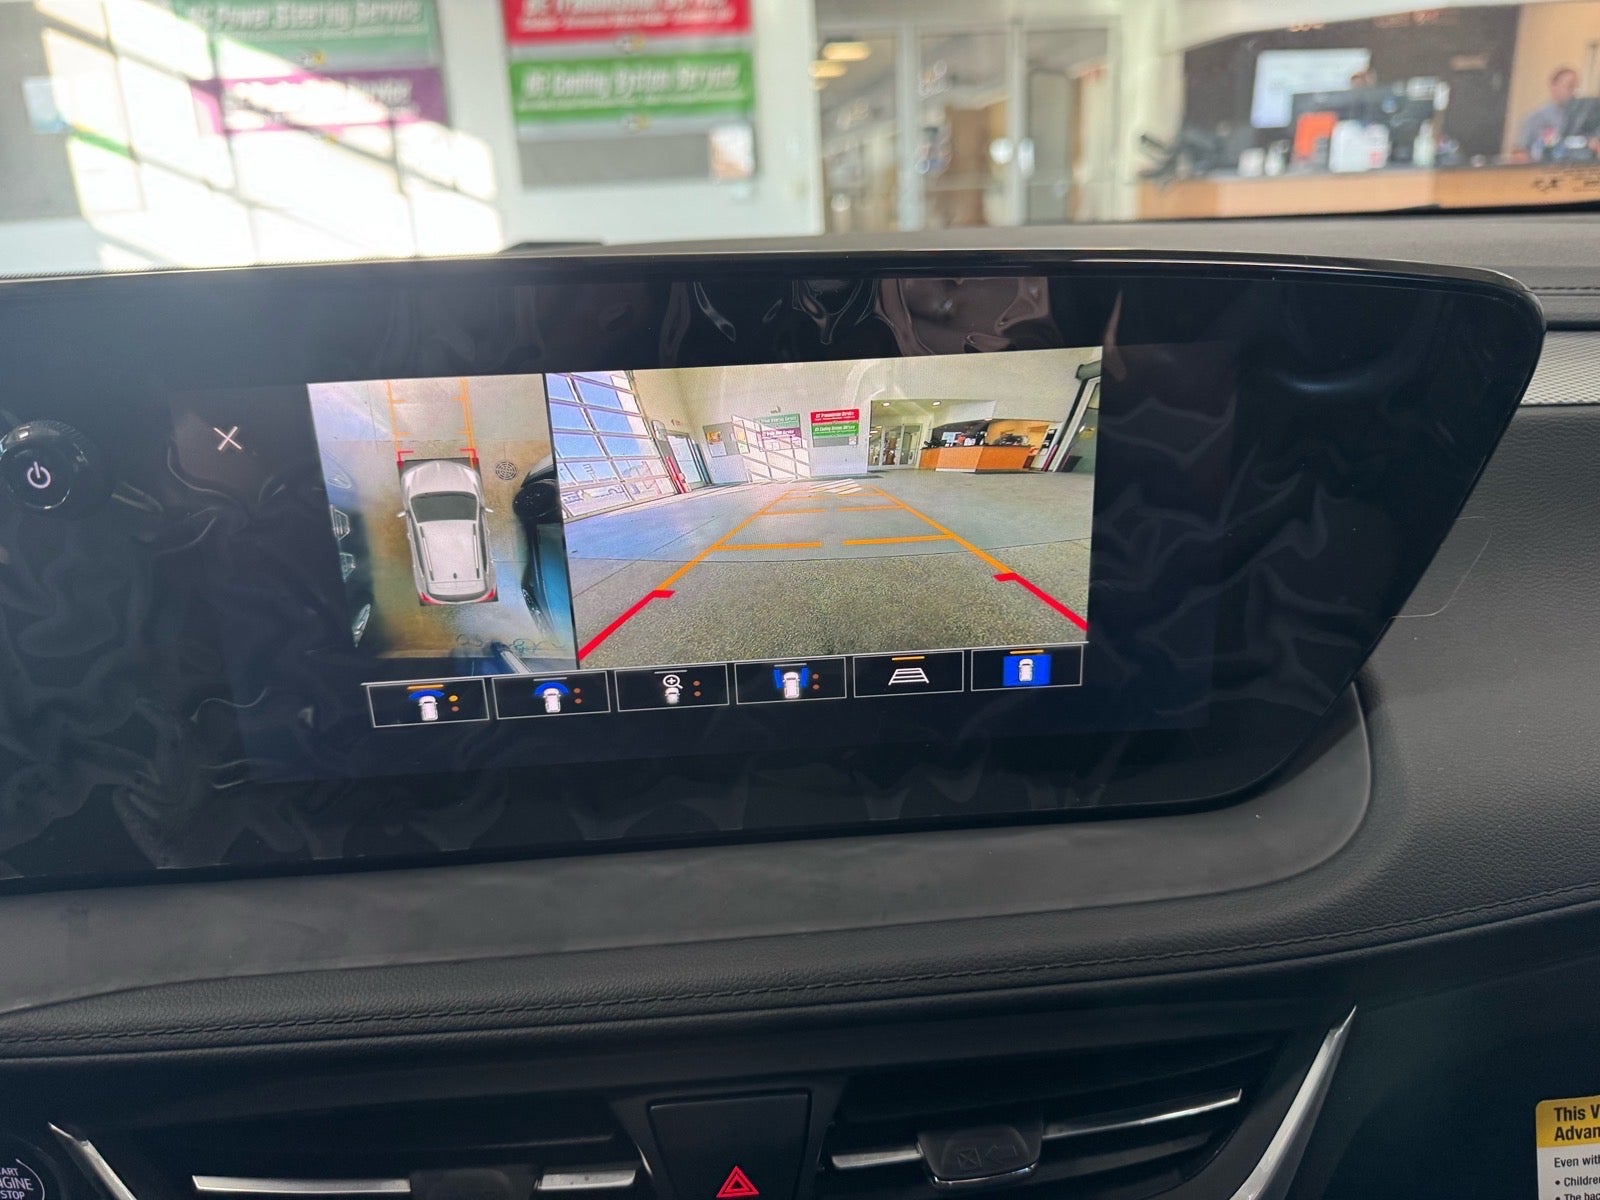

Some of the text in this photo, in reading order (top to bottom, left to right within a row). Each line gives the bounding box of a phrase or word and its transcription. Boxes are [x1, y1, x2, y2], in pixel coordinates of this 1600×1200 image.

[1553, 1105, 1586, 1122] This
[1554, 1157, 1579, 1168] Even
[0, 1167, 19, 1176] ART
[1564, 1175, 1600, 1187] Childre
[0, 1190, 25, 1200] STOP
